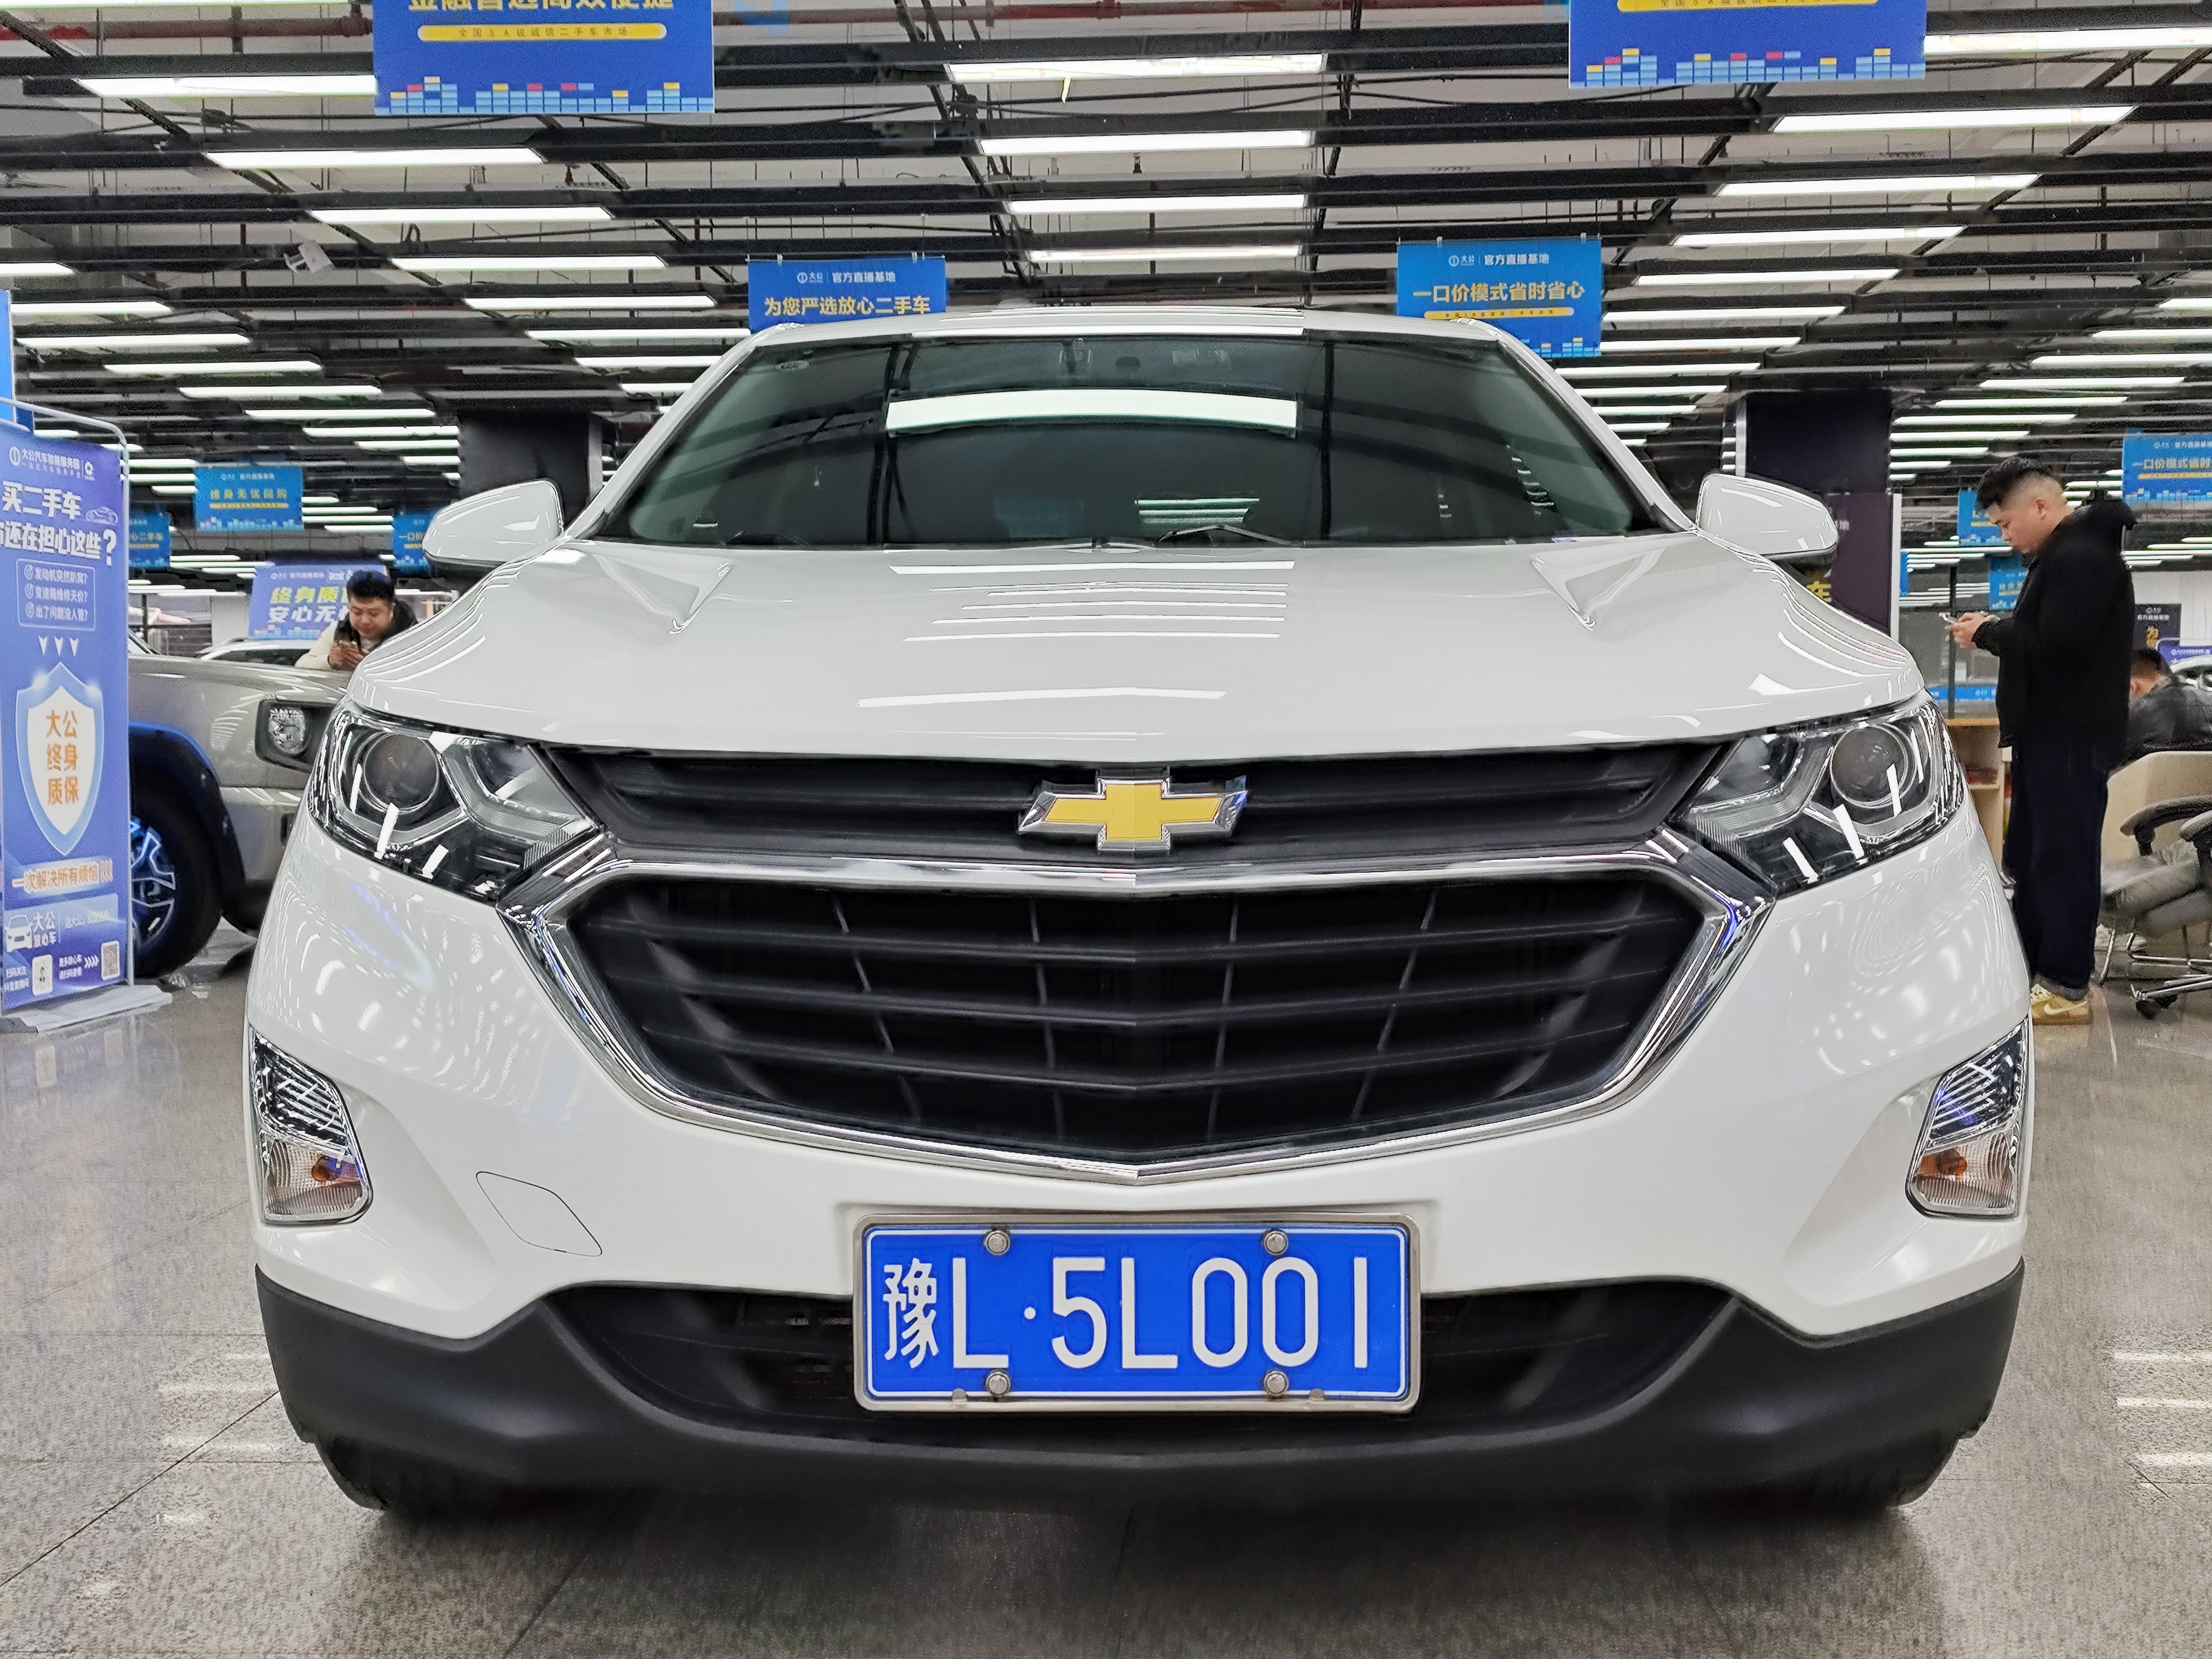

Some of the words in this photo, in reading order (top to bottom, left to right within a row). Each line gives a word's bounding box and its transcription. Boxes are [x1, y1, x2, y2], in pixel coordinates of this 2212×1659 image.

[1484, 253, 1550, 266] 官方直播基地
[832, 271, 896, 283] 官方直播基地
[1413, 280, 1585, 302] 一口价模式省时省心
[764, 295, 930, 316] 为您严选放心二手车
[2, 480, 82, 520] 买二手车
[270, 586, 349, 604] 终身质
[46, 710, 78, 738] 大公
[46, 743, 79, 772] 终身
[48, 775, 79, 806] 质保
